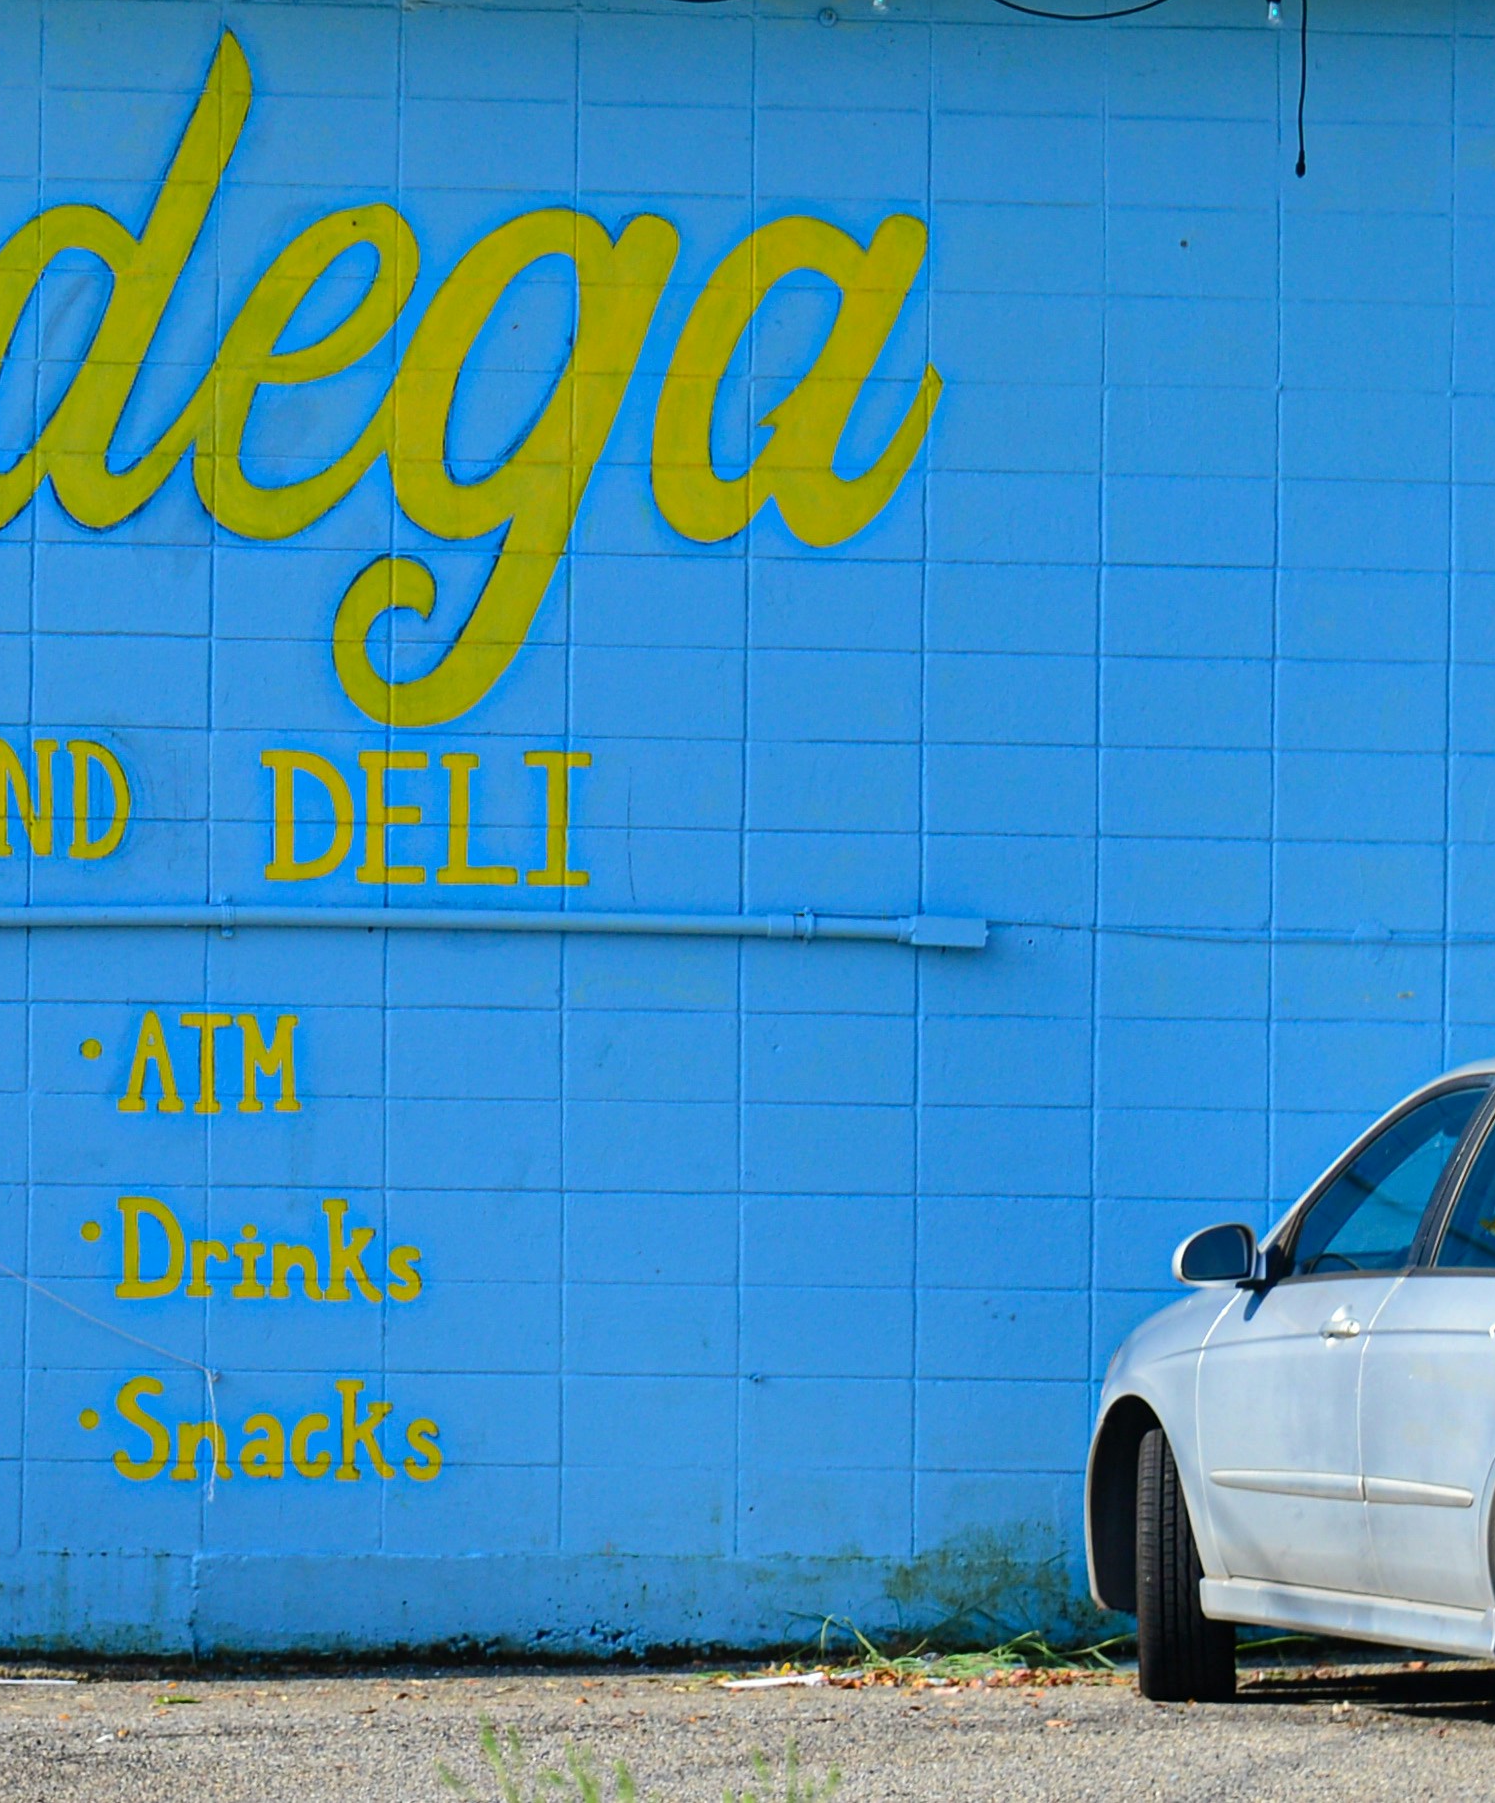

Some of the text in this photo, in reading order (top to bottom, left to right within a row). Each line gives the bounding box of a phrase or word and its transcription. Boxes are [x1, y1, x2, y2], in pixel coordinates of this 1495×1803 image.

[261, 750, 592, 886] DELI
[117, 1010, 301, 1114] ATM
[115, 1196, 422, 1302] Drinks
[113, 1375, 443, 1481] Snacks
